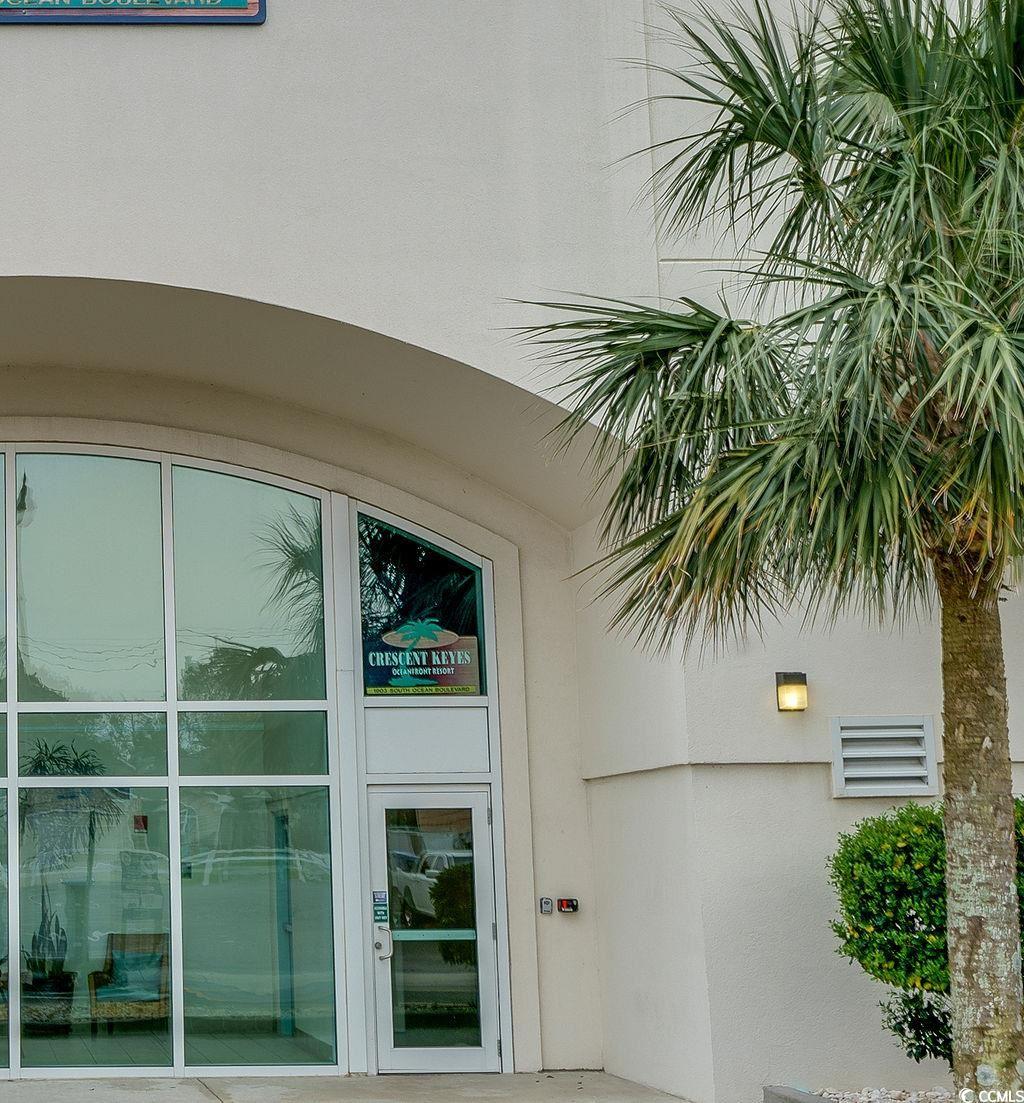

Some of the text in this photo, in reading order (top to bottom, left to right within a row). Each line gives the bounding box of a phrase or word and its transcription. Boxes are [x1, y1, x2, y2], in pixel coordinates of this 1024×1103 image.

[368, 650, 471, 666] CRESCENT KEYES
[392, 667, 455, 676] OCEANFRONT RESORT
